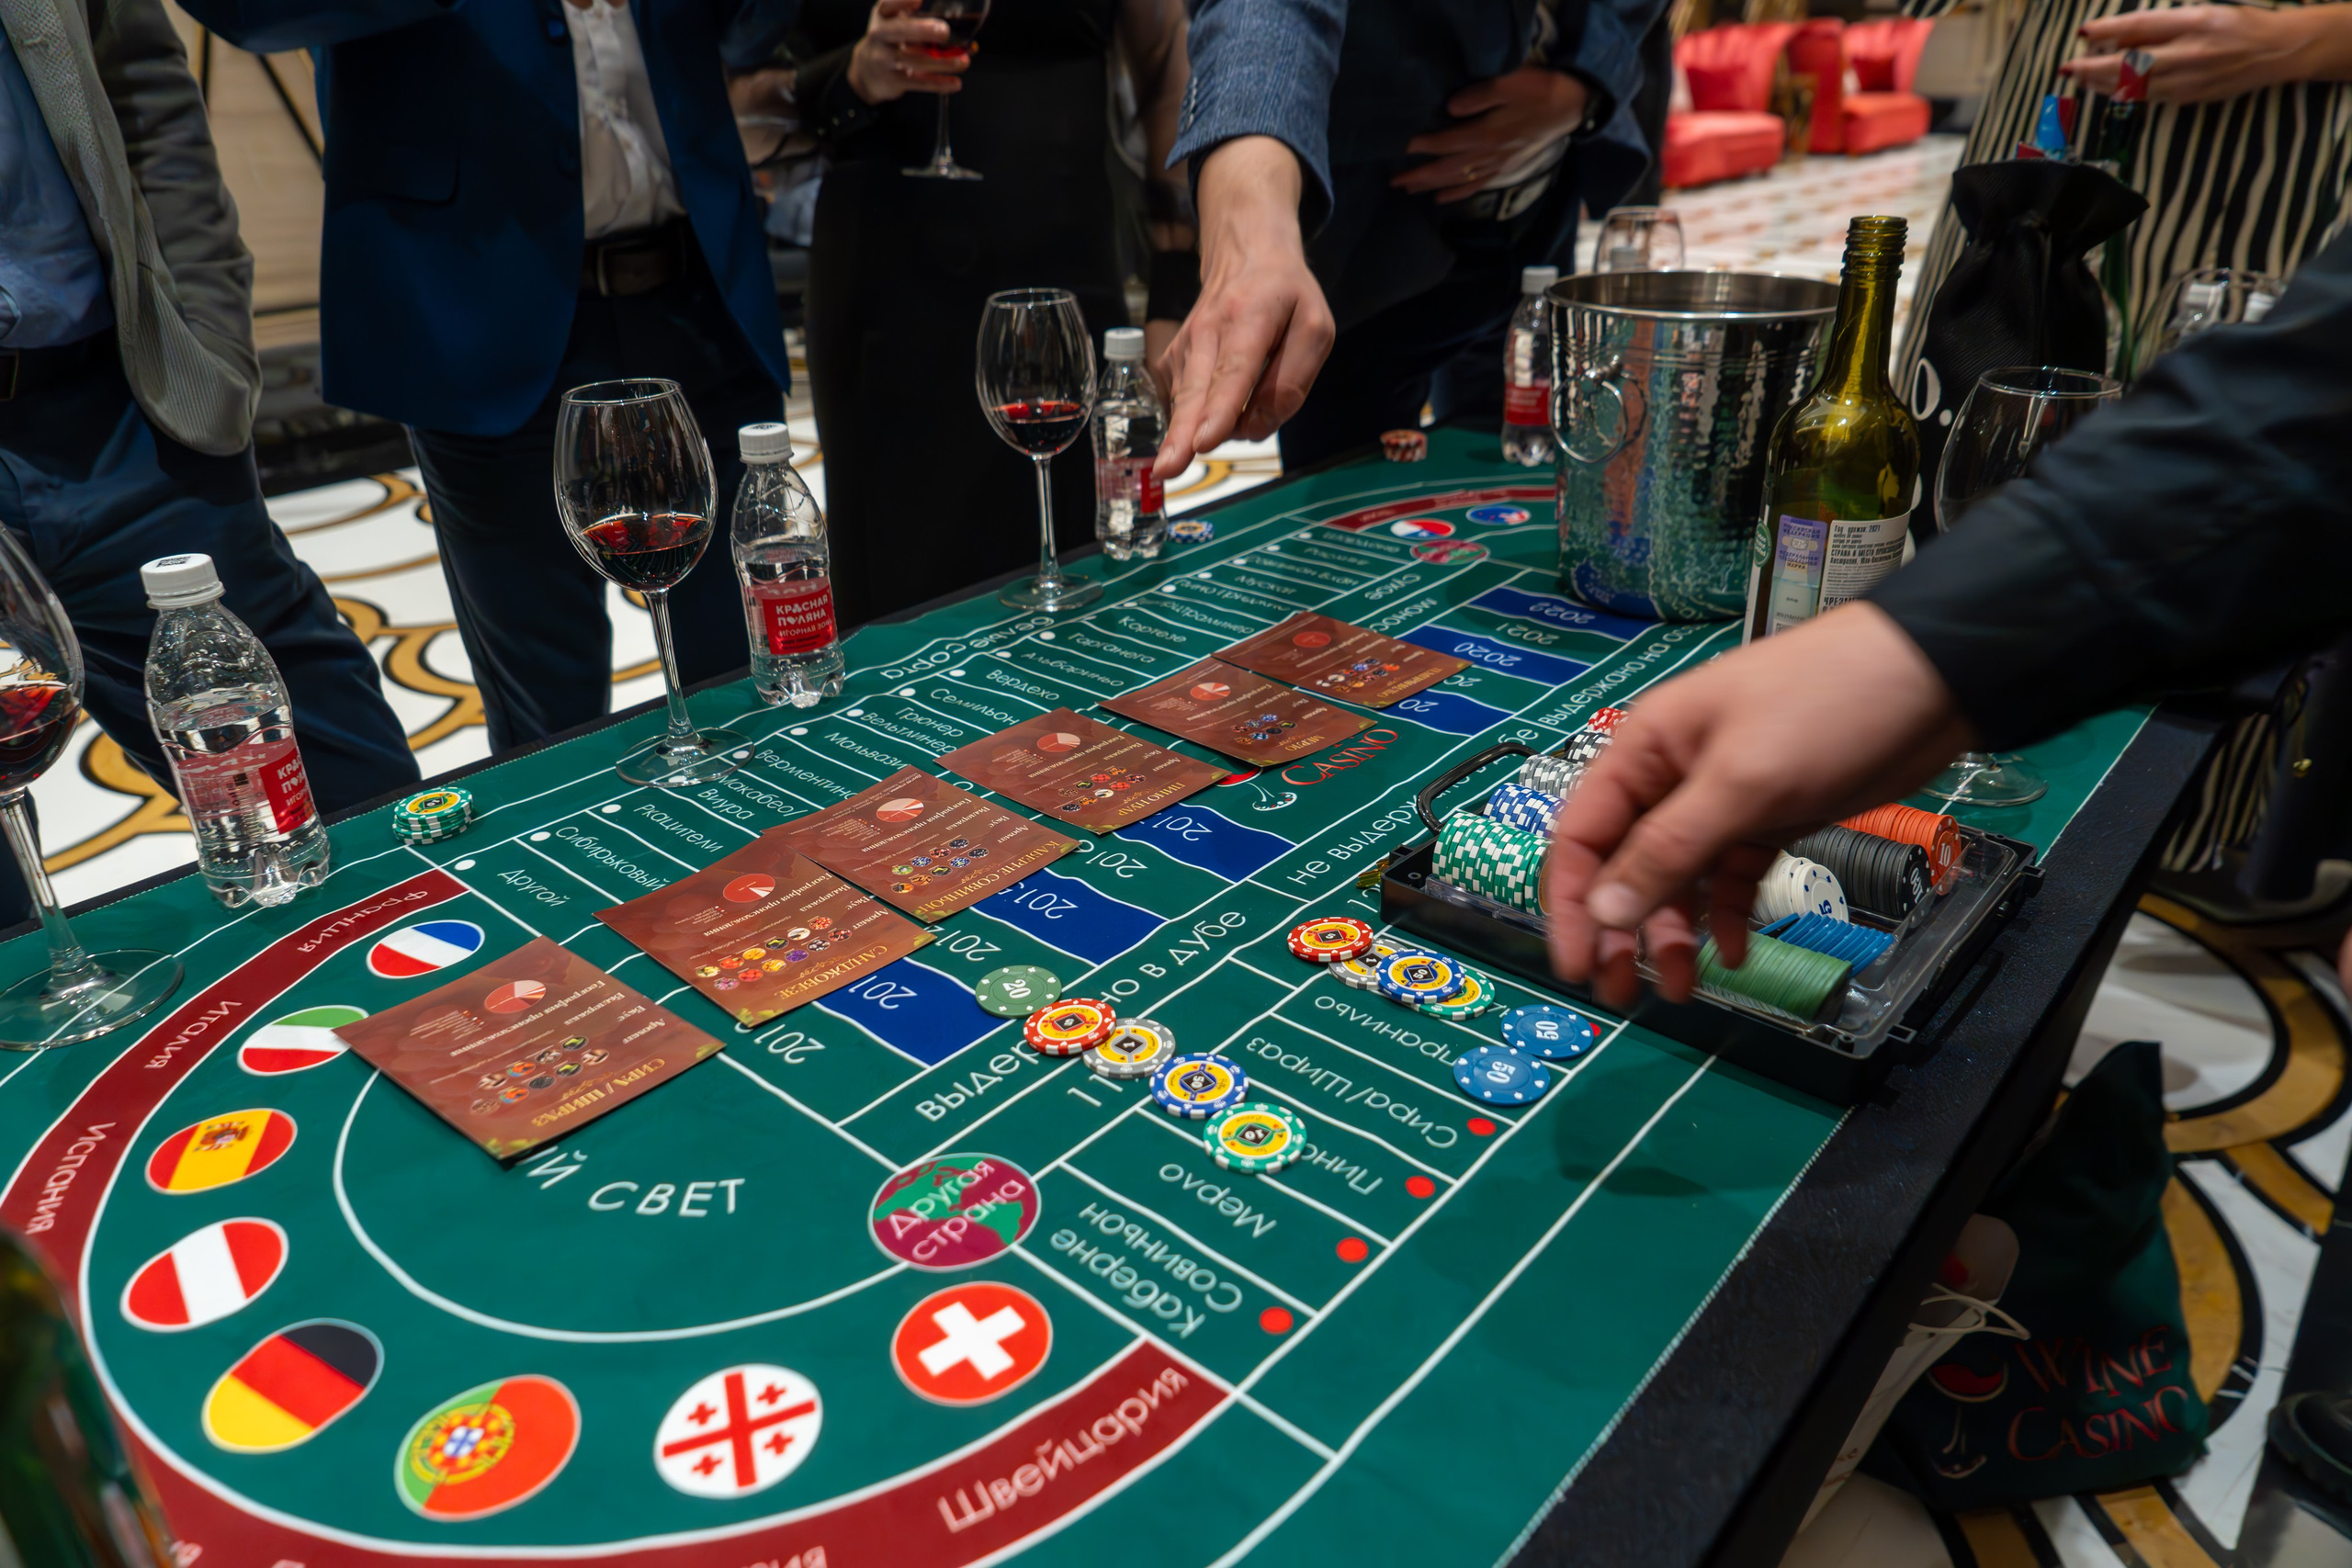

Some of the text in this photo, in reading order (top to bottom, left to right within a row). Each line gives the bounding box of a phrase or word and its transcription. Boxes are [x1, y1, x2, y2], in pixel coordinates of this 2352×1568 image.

[1528, 602, 1596, 626] 2022
[1068, 633, 1156, 664] Гарганега
[1495, 623, 1560, 645] 2021
[1021, 651, 1125, 688] Альбариньо
[1453, 642, 1522, 667] 2020
[986, 669, 1060, 701] Вердехо
[1443, 674, 1483, 688] 20
[1537, 641, 1671, 726] выдержано на
[895, 706, 964, 738] Грюнер
[930, 688, 1020, 726] Семильон
[1398, 699, 1440, 713] 20
[824, 732, 910, 771] Мальвази
[861, 712, 958, 755] Вельтлинер
[1282, 728, 1398, 785] CASINO
[697, 788, 755, 820] Виура
[923, 796, 973, 823] География
[943, 805, 990, 831] Выдержка
[984, 814, 1012, 829] Вкус
[634, 804, 724, 853] Ркацители
[860, 818, 928, 855] происхождения
[993, 823, 1032, 844] Аромат
[555, 826, 670, 891] Сибирьковый
[1939, 842, 1951, 867] 10
[497, 869, 571, 907] Другой
[776, 872, 836, 902] География
[916, 839, 1062, 916] КАБЕРНЕ СОВИНЬОН
[1286, 860, 1331, 886] не
[796, 884, 853, 912] Выдержка
[841, 895, 871, 910] Вкус
[1819, 899, 1832, 915] 5
[298, 889, 428, 953] Франция
[702, 898, 782, 938] происхождения
[847, 907, 892, 930] Аромат
[775, 944, 888, 1001] САНДЖОВЕЗЕ
[1001, 978, 1031, 999] 20
[1413, 968, 1429, 980] 50
[848, 974, 919, 1010] 201
[144, 999, 243, 1070] Италия
[915, 978, 1140, 1122] выдерно
[1169, 911, 1246, 965] дубе
[1315, 996, 1461, 1067] пранильо
[1535, 1021, 1559, 1041] 50
[612, 1058, 666, 1088] СИРА
[1191, 1075, 1204, 1089] 50
[1487, 1061, 1516, 1084] 50
[531, 1089, 606, 1127] ШИРАЗ
[1244, 1129, 1264, 1140] 10
[26, 1121, 117, 1235] Испания
[588, 1178, 746, 1218] СВЕТ
[887, 1160, 996, 1241] Другая
[1159, 1164, 1278, 1239] Мерло
[910, 1179, 1026, 1262] страна
[1077, 1201, 1243, 1313] Совиньон
[1049, 1228, 1205, 1339] Каберне
[2014, 1325, 2173, 1397] WINE
[2007, 1385, 2188, 1461] CASINO
[937, 1366, 1189, 1533] Швейцария
